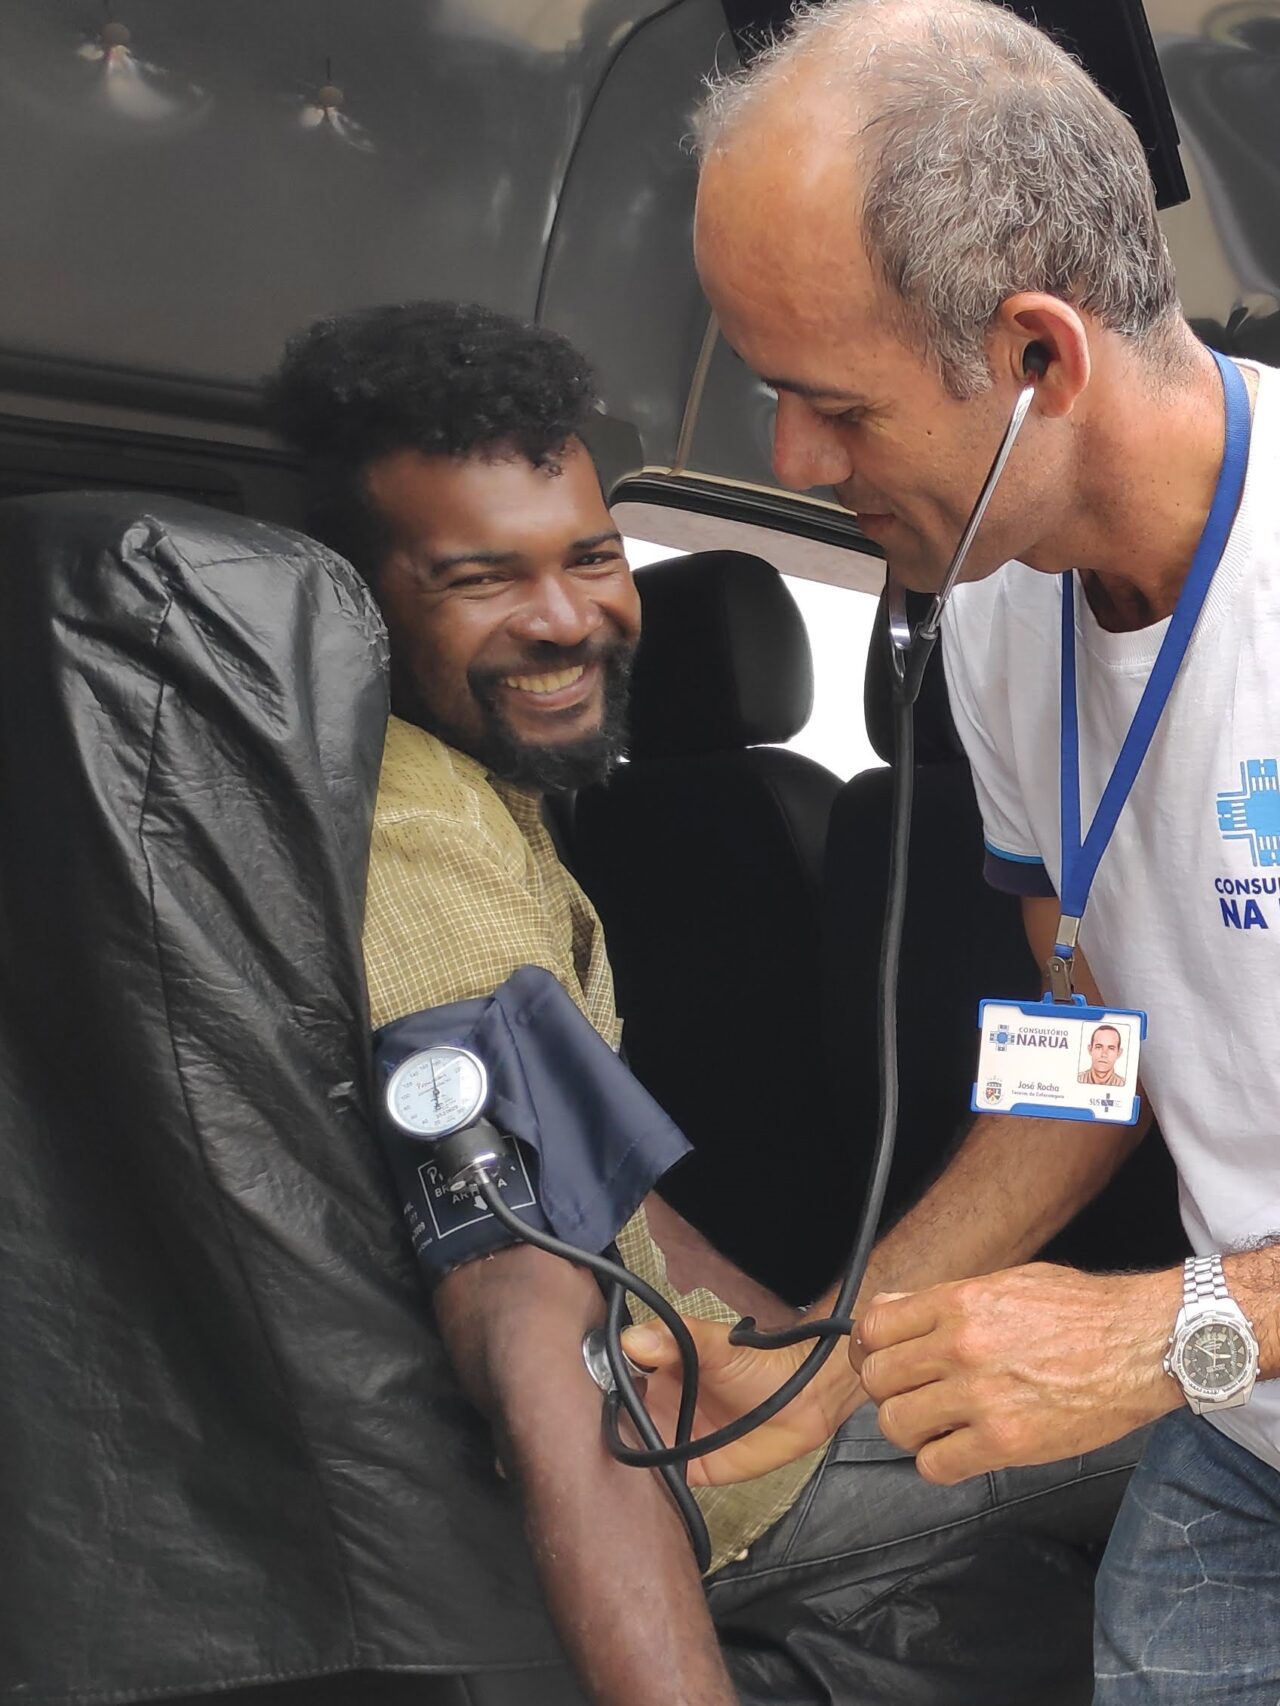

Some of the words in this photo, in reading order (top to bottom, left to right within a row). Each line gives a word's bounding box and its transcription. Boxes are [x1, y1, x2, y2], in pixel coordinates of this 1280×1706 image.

[1219, 897, 1269, 930] NA
[1018, 1026, 1069, 1037] CONSULTÓRIO
[1018, 1081, 1034, 1090] José
[1036, 1082, 1060, 1092] Rocha
